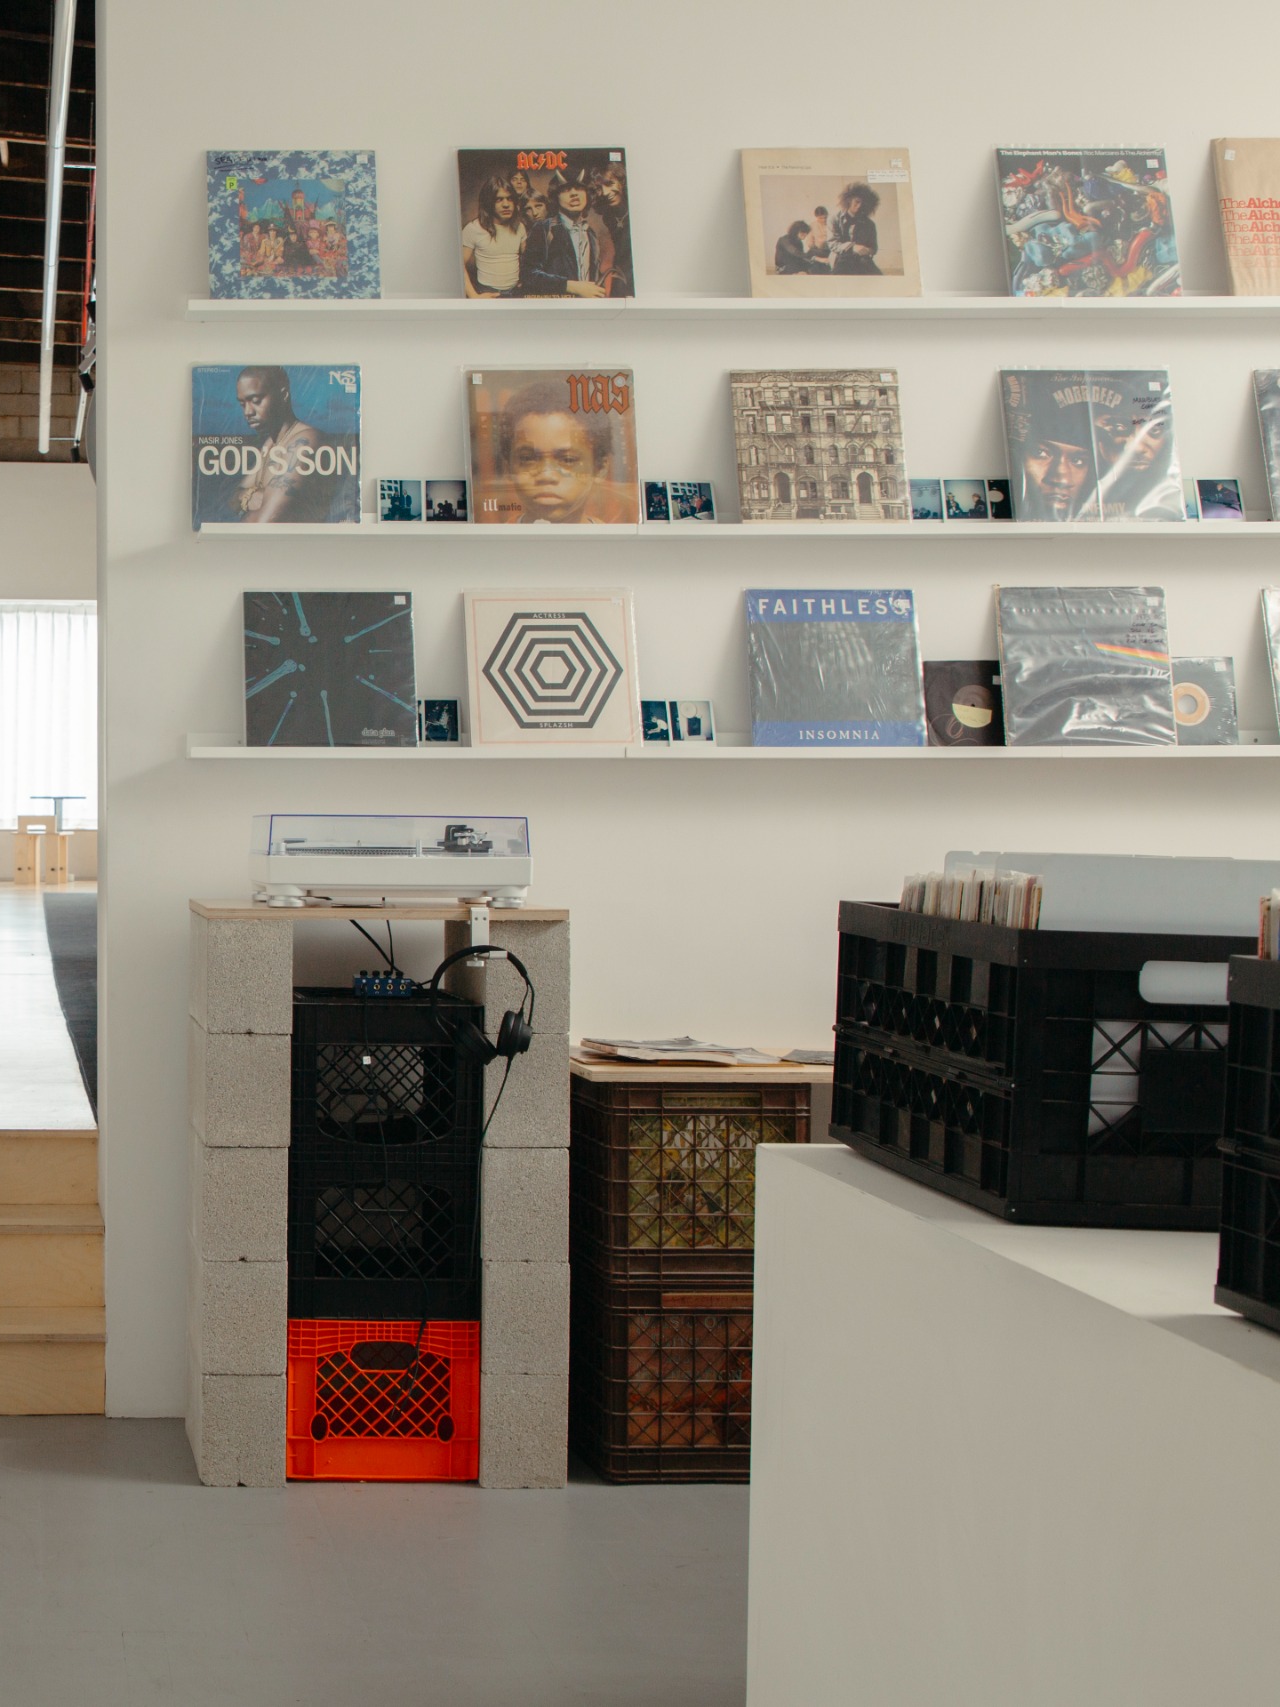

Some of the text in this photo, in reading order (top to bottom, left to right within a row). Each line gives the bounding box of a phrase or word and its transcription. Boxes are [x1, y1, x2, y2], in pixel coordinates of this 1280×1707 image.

[198, 437, 243, 445] NASIR JONES
[198, 445, 357, 476] GOD'S SON
[799, 730, 880, 740] INSOMNIA
